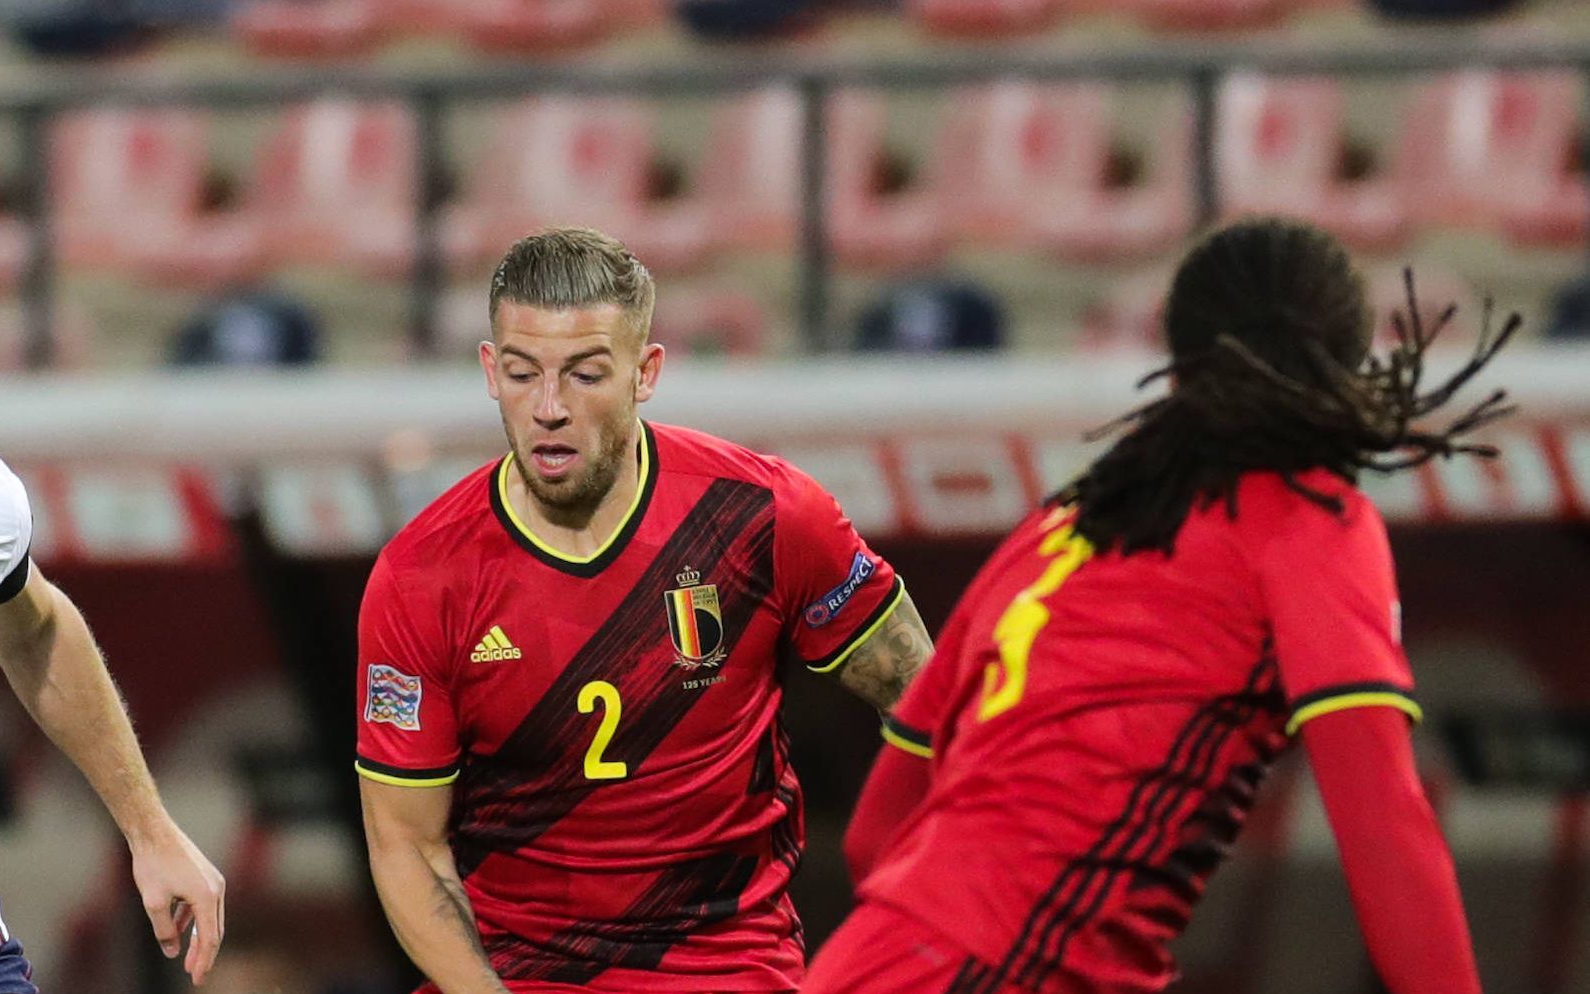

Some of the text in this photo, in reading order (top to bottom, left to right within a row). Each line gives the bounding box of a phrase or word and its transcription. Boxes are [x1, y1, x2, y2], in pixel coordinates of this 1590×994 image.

[827, 555, 872, 610] RESPECT
[470, 647, 522, 663] adidas
[576, 680, 628, 780] 2
